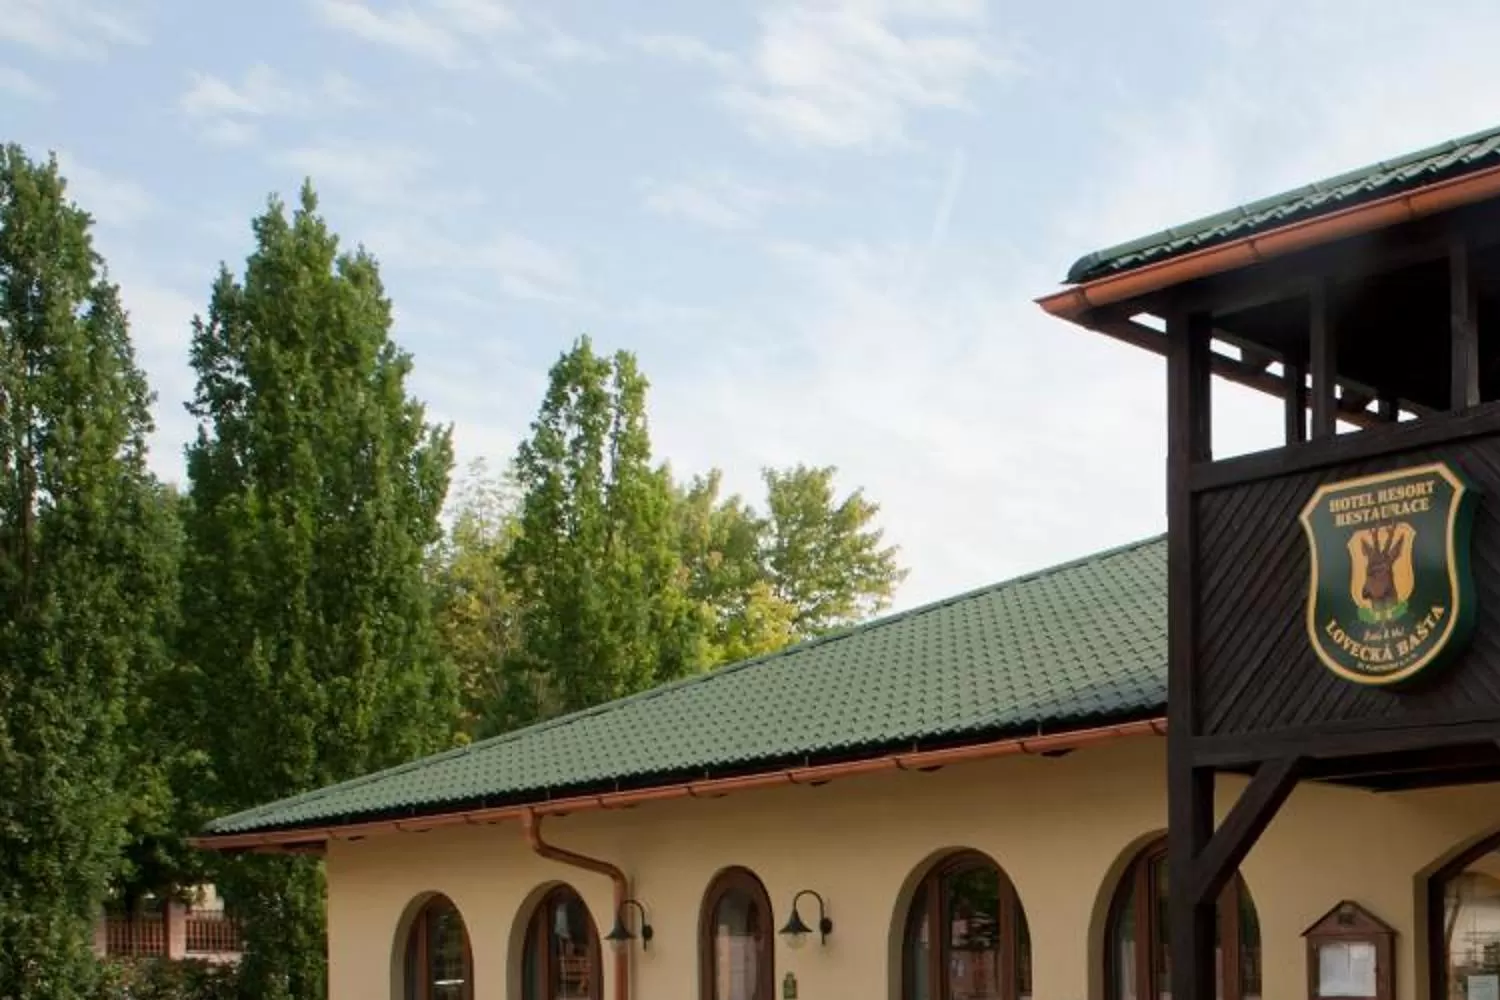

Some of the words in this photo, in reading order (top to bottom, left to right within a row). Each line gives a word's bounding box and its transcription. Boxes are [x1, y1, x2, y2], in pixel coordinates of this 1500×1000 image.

[1329, 491, 1376, 513] HOTEL
[1377, 479, 1435, 504] RESORT
[1335, 497, 1430, 527] RESTAURACE
